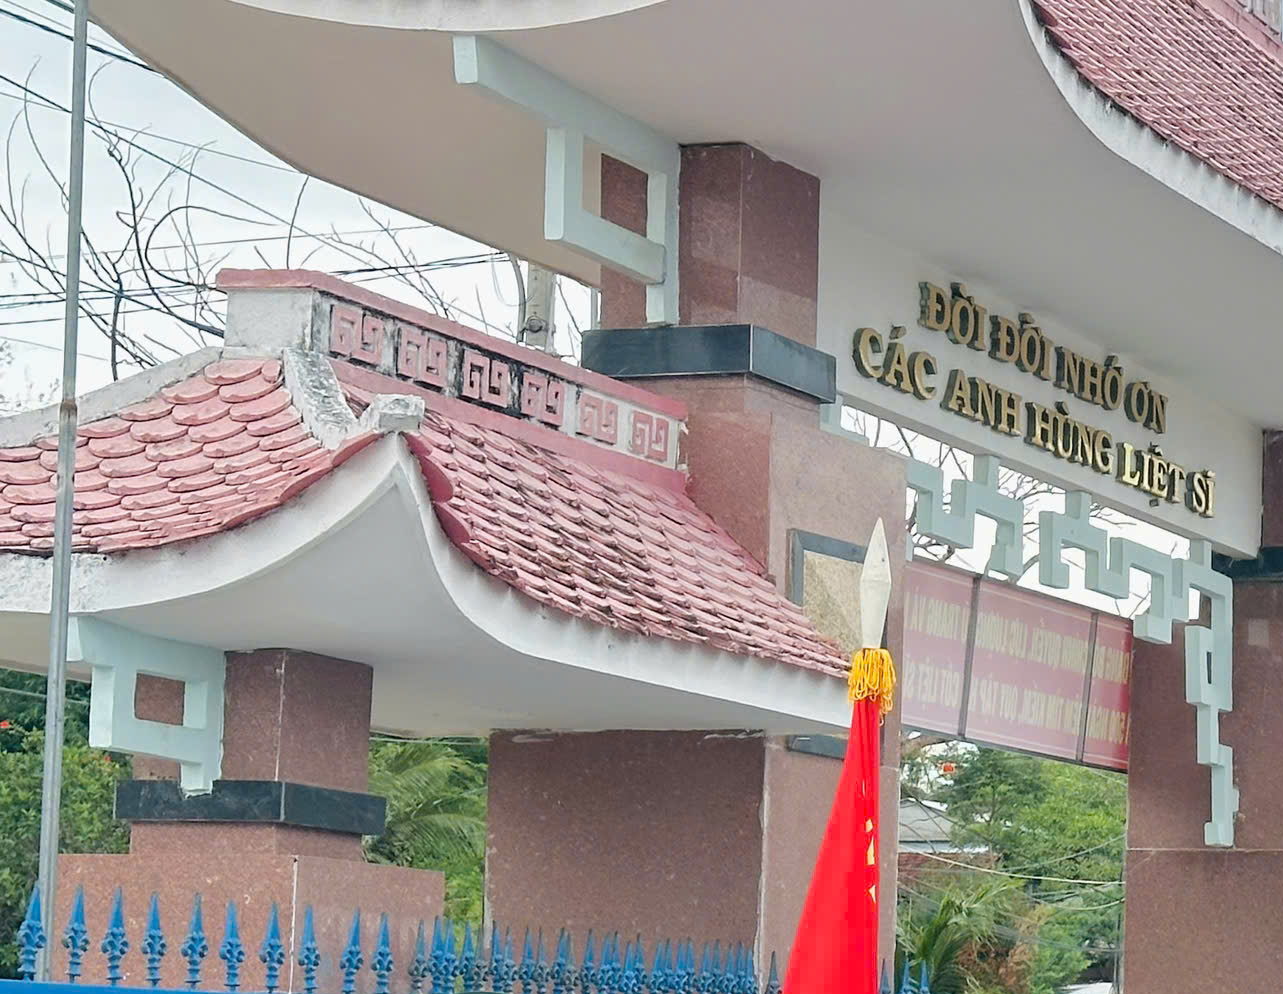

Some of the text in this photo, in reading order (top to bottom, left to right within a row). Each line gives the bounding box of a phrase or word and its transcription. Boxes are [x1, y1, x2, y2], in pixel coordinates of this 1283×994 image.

[852, 325, 938, 400] CÁC
[941, 369, 1021, 437] ANH
[1024, 401, 1113, 475] HÙNG
[1116, 442, 1186, 508] LIỆT
[917, 281, 1169, 434] ĐỜI ĐỜI NHỚ ƠN
